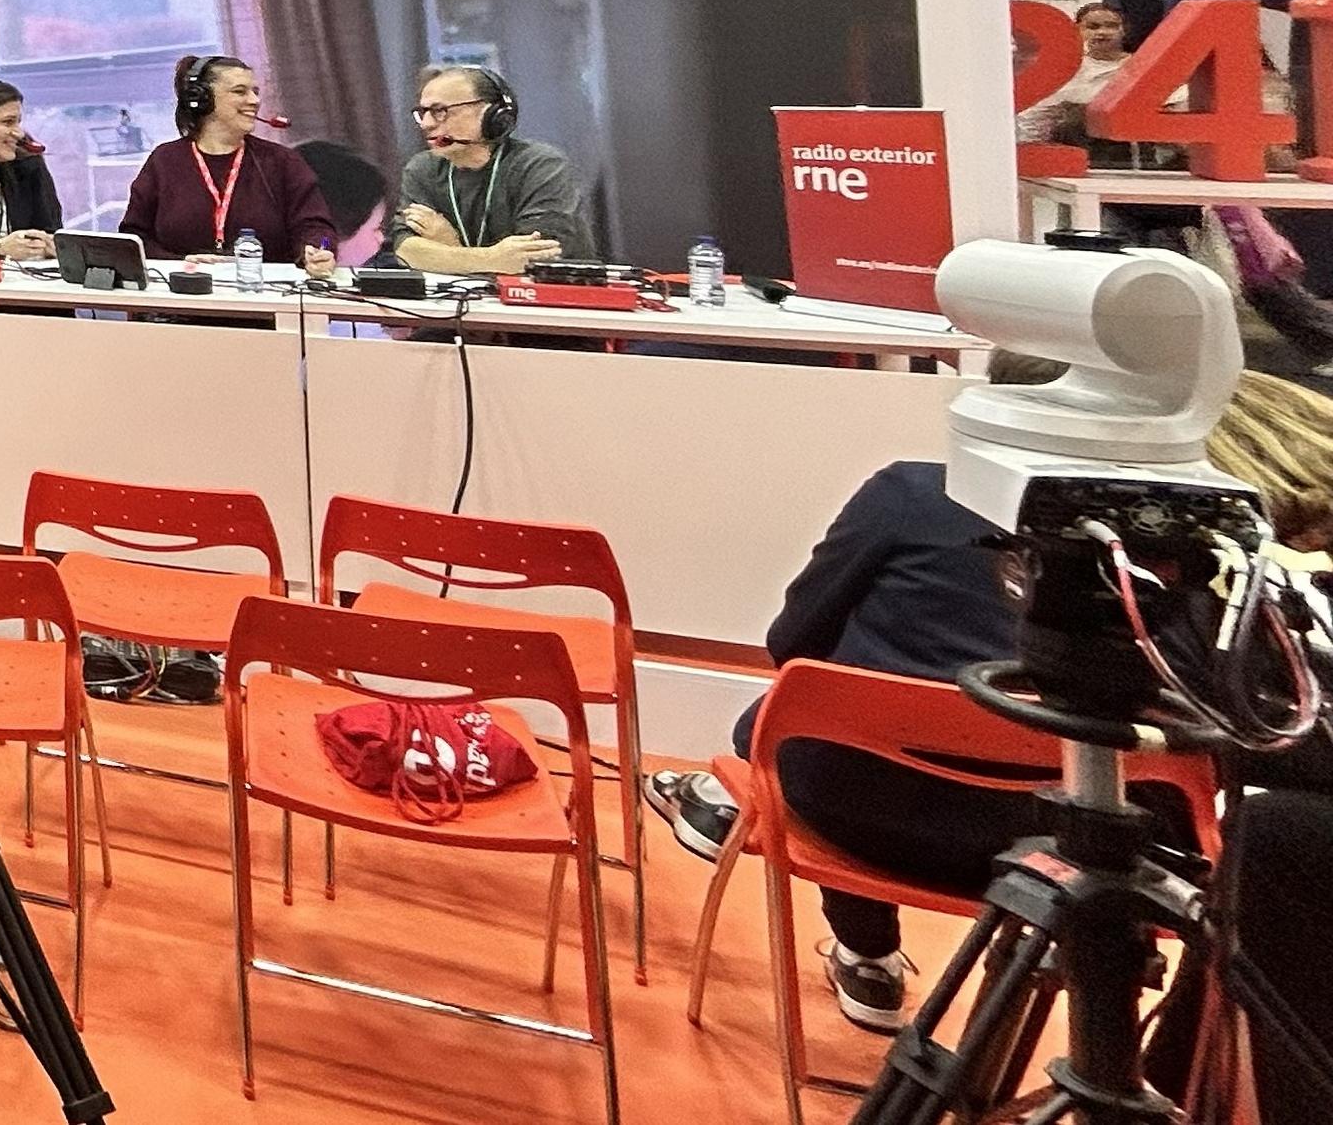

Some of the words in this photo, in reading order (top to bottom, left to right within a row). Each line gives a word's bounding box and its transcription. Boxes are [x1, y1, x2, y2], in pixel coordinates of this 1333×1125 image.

[791, 143, 847, 161] radio
[849, 146, 938, 164] exterior
[793, 165, 869, 200] rne
